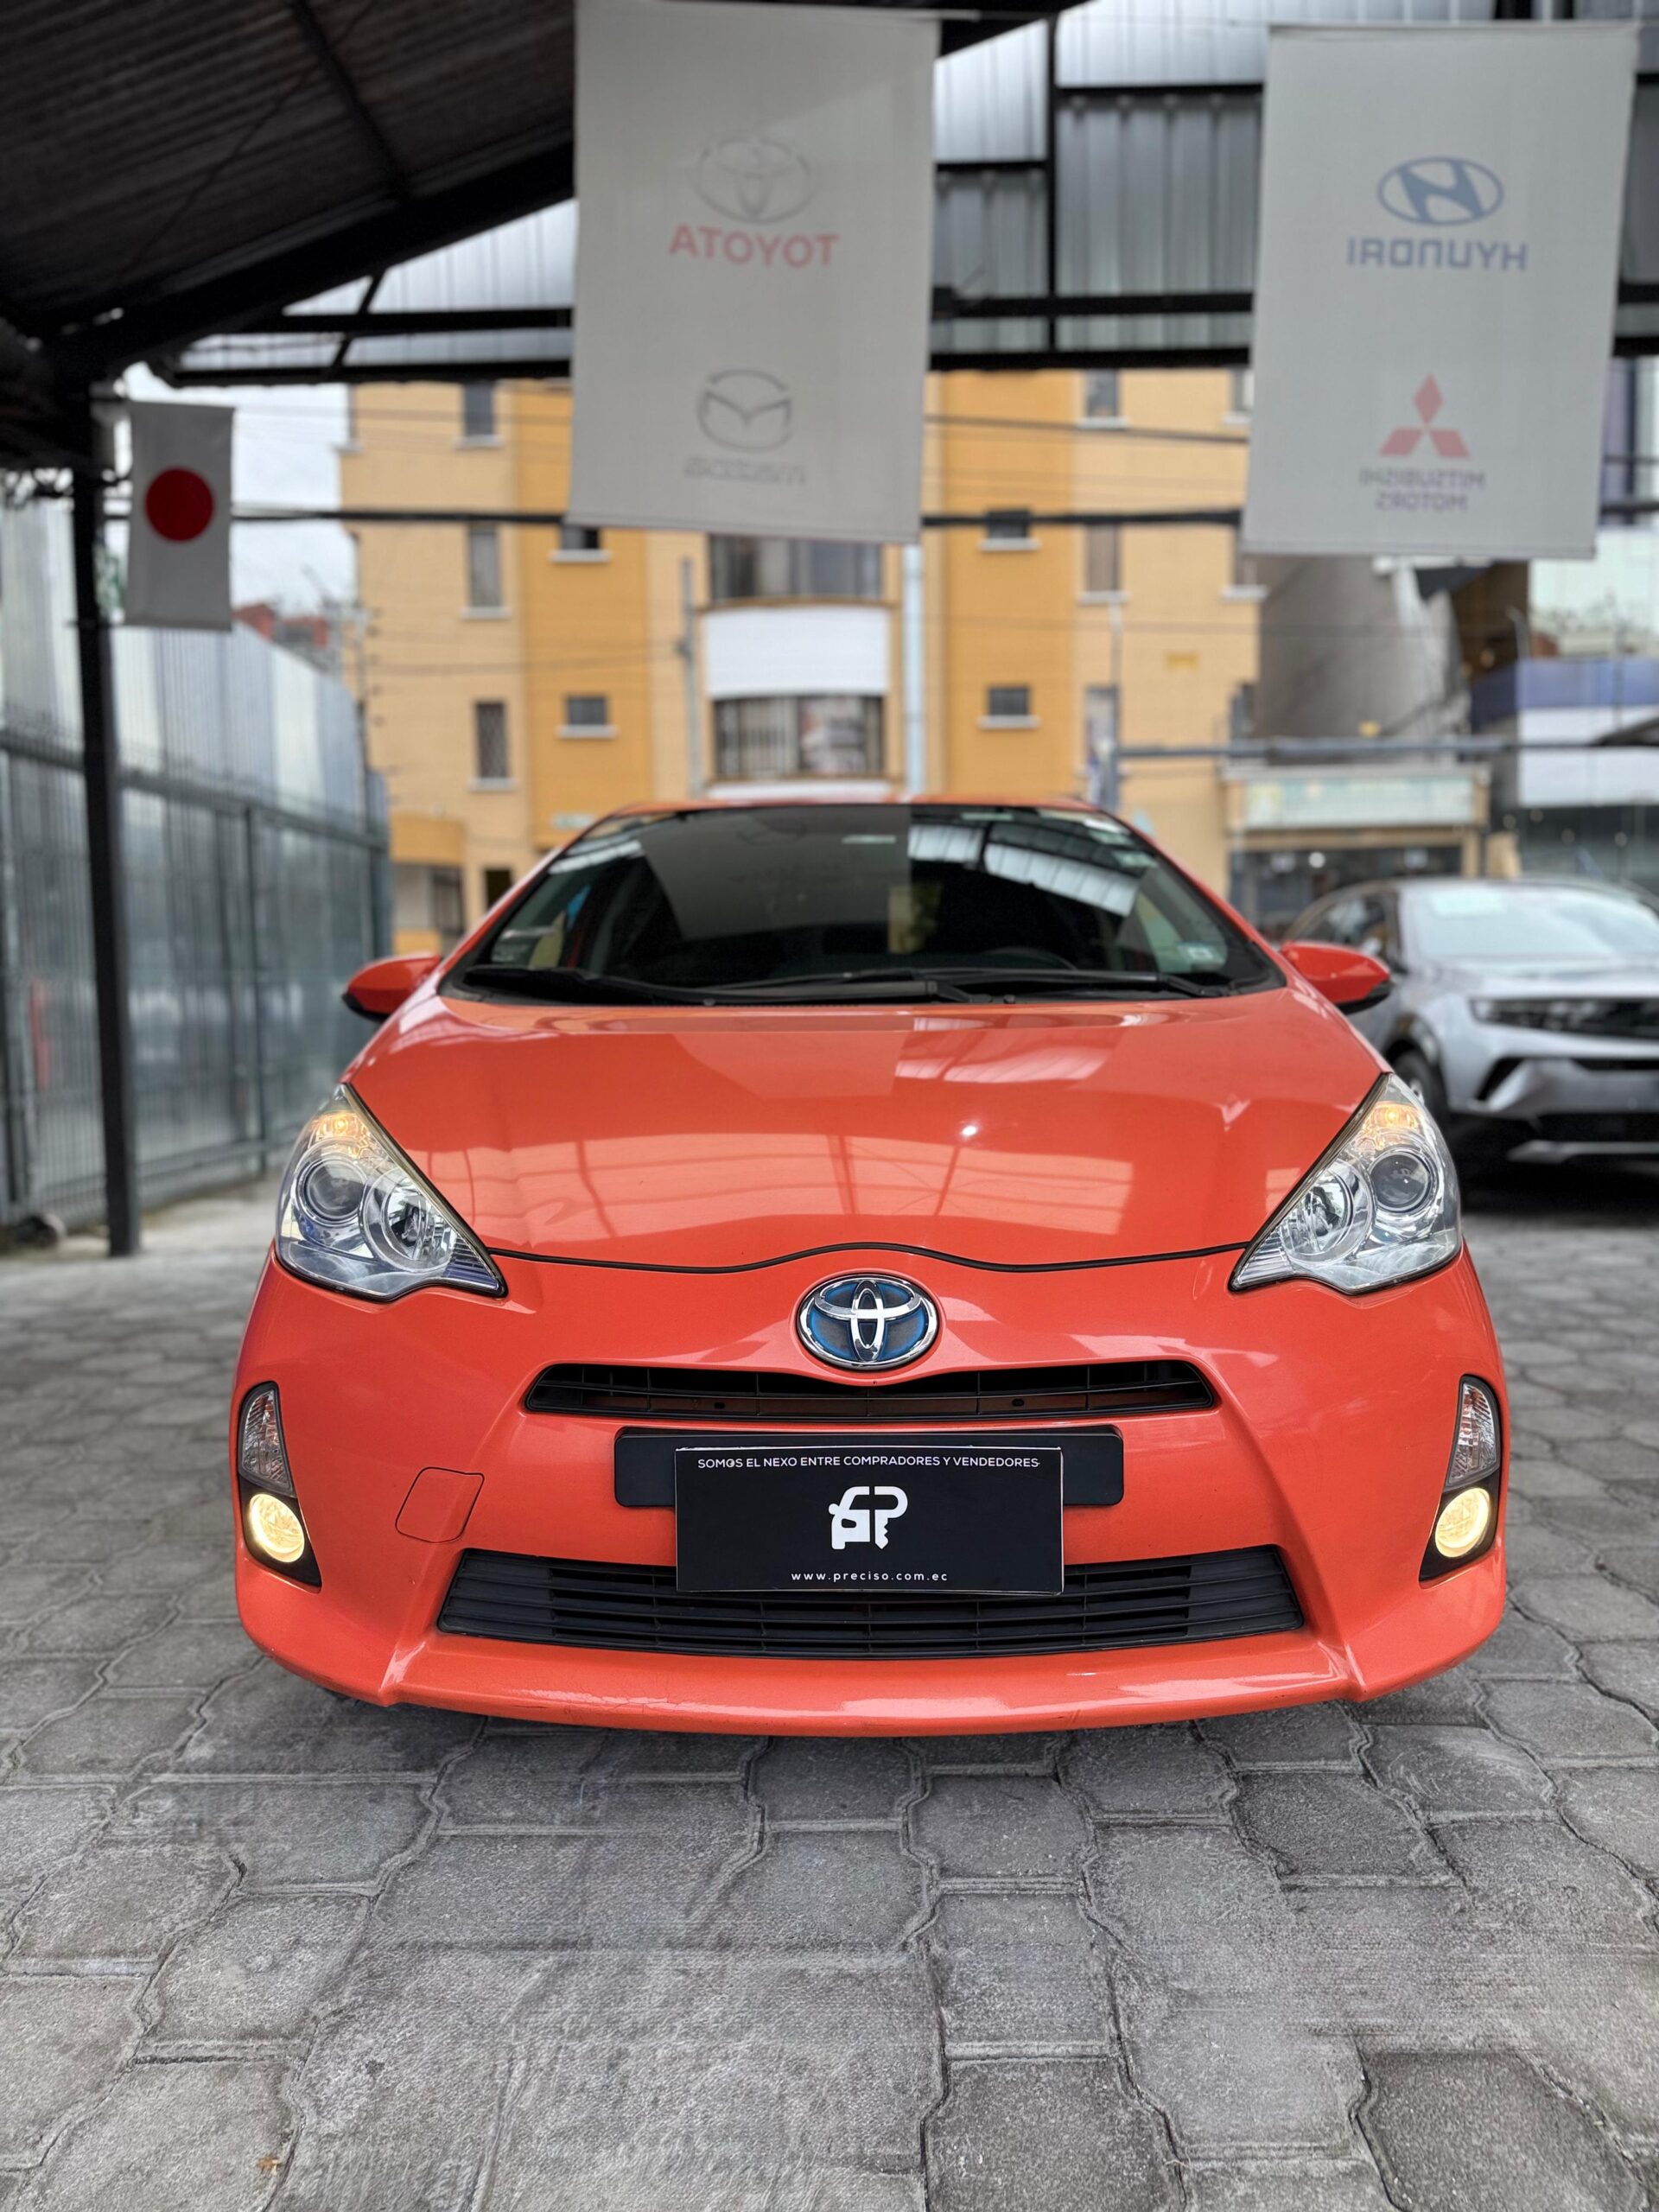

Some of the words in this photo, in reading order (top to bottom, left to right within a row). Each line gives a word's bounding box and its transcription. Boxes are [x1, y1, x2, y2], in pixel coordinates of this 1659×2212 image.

[697, 1458, 744, 1469] SOMOS
[746, 1458, 761, 1468] EL
[763, 1457, 798, 1467] NEXO
[800, 1456, 841, 1466] ENTRE
[842, 1455, 941, 1466] COMPRADORES
[942, 1456, 951, 1466] Y
[952, 1456, 1039, 1468] VENDEDORES
[791, 1571, 948, 1583] www.preciso.com.ec
